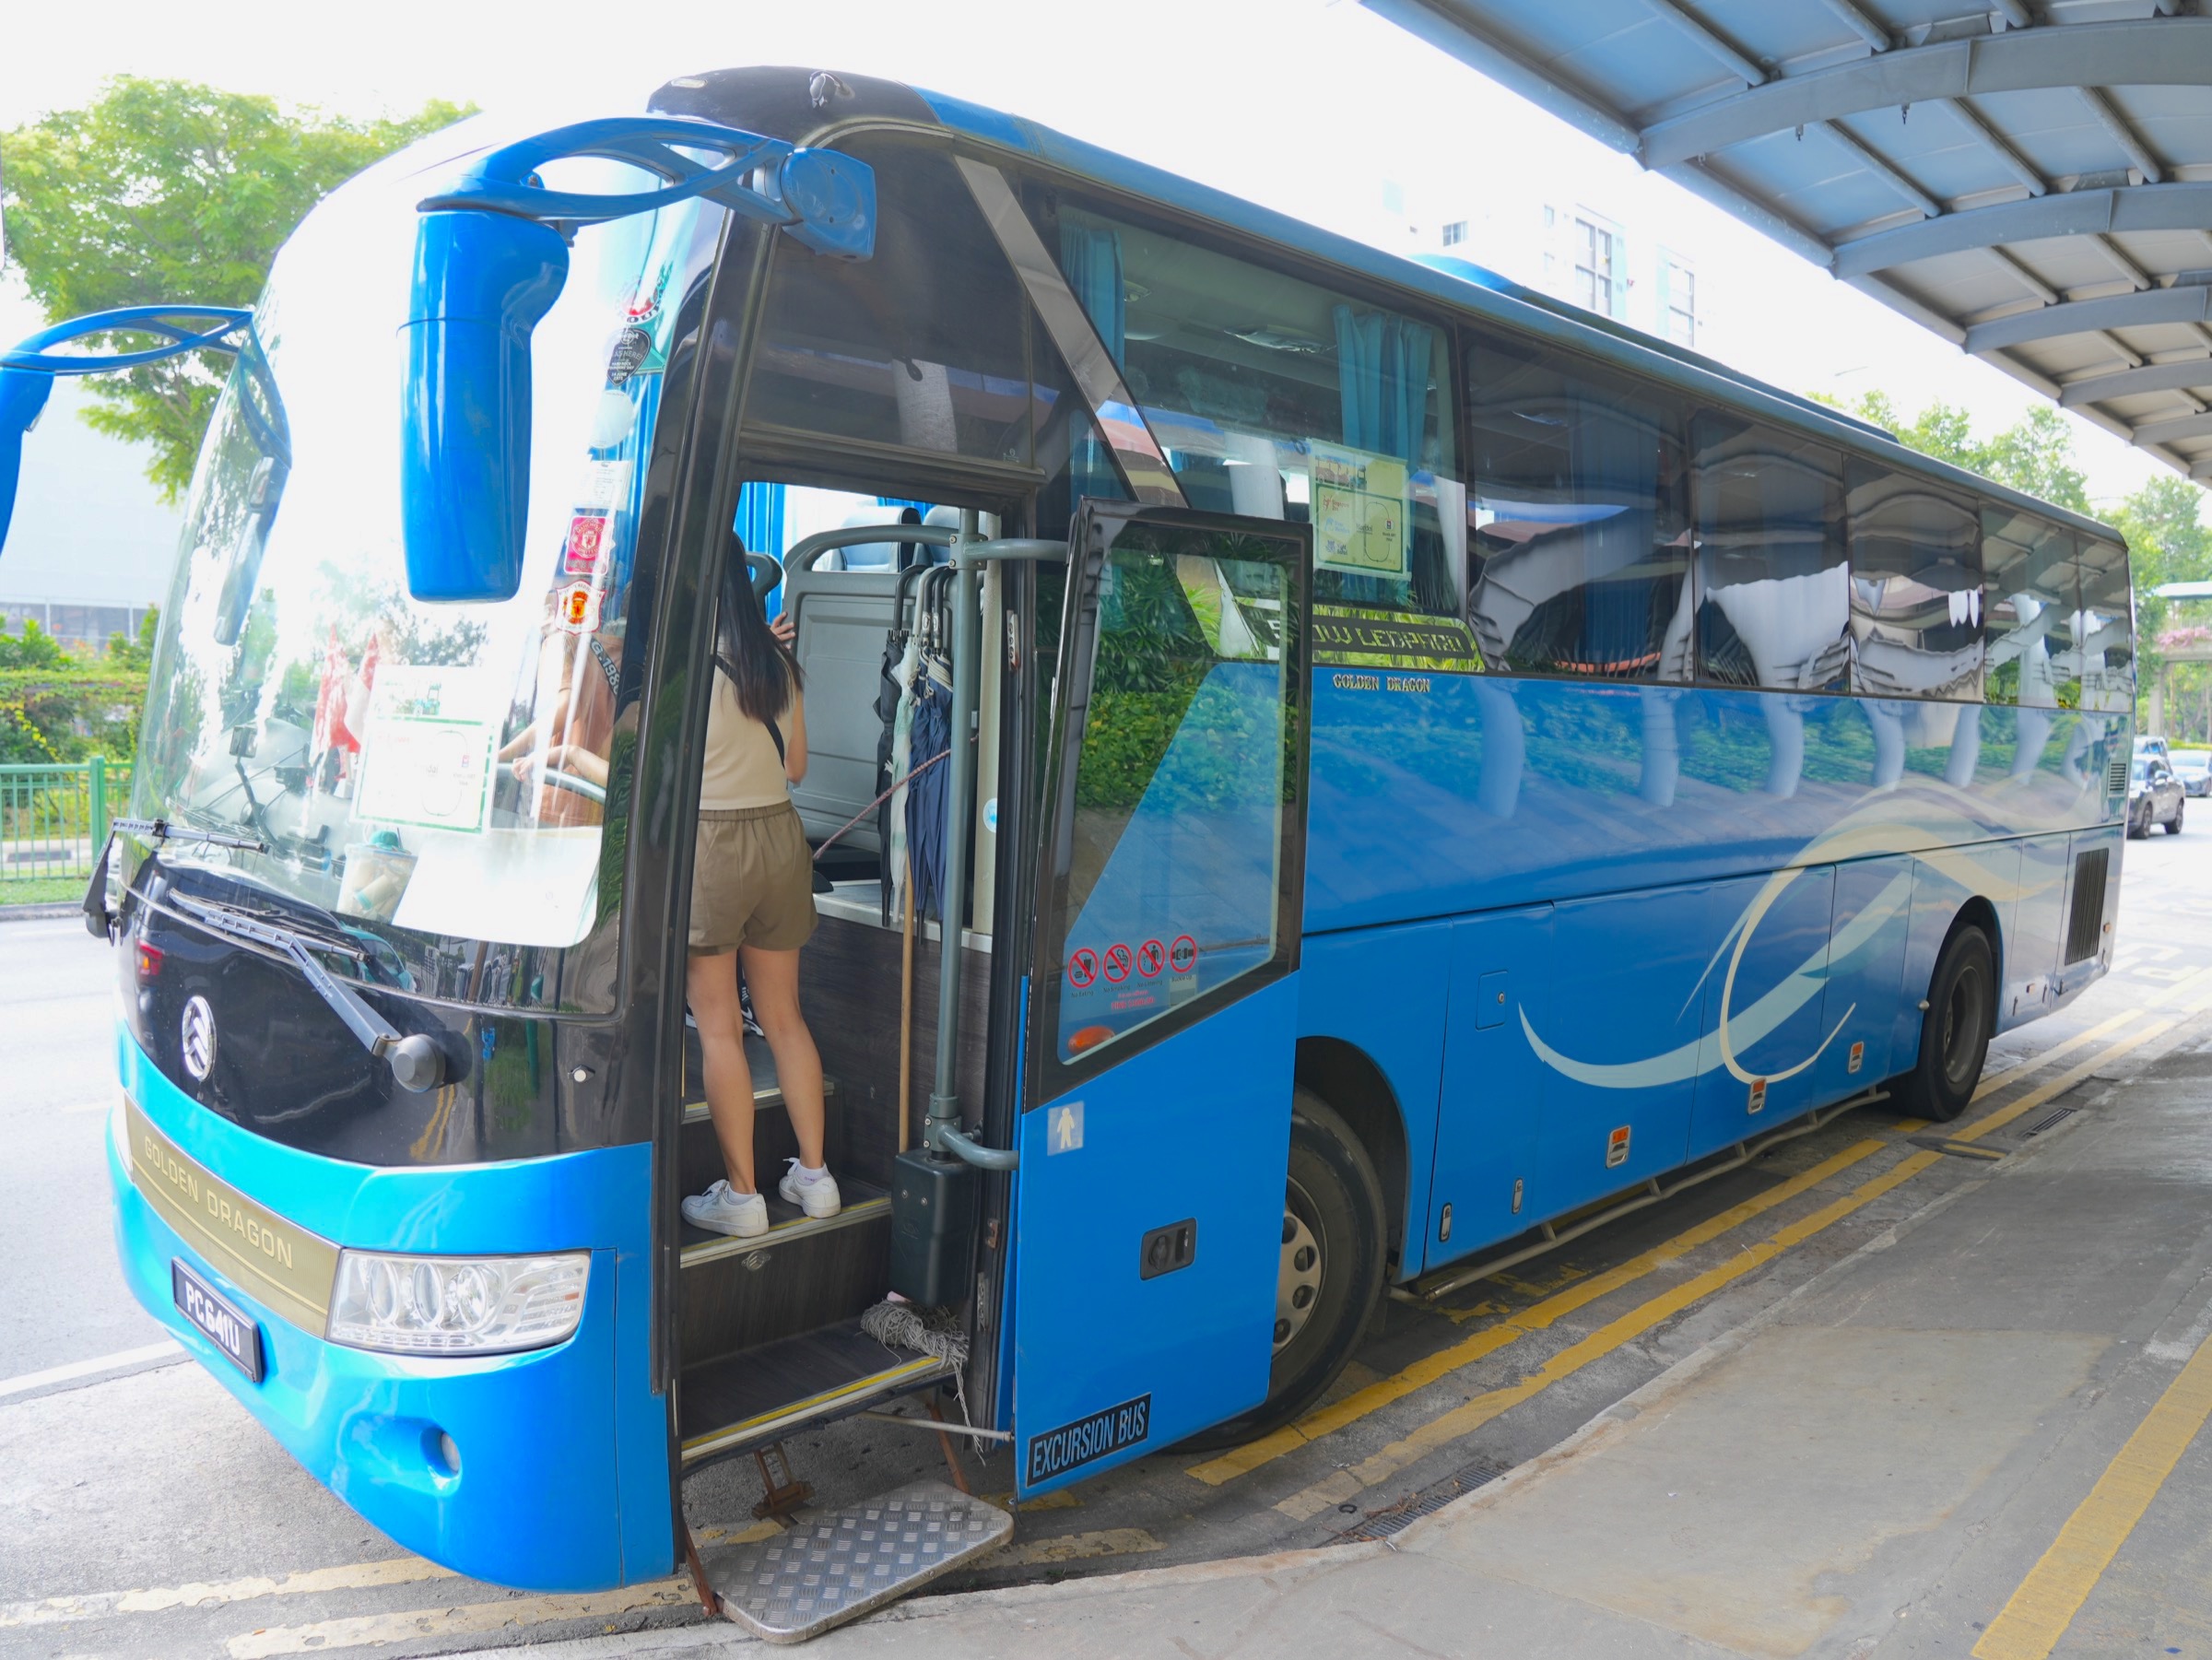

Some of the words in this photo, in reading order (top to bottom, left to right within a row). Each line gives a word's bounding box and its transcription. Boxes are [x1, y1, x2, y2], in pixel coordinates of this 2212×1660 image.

[1333, 674, 1380, 691] GOLDEN
[1386, 677, 1430, 692] DRAGON
[1078, 990, 1094, 998] Eating
[1111, 984, 1131, 993] Smoking
[144, 1135, 199, 1203] GOLDEN
[206, 1190, 293, 1270] DRAGON
[185, 1280, 241, 1357] PC641U
[1032, 1413, 1115, 1478] EXCURSION
[1118, 1401, 1147, 1444] BUS
